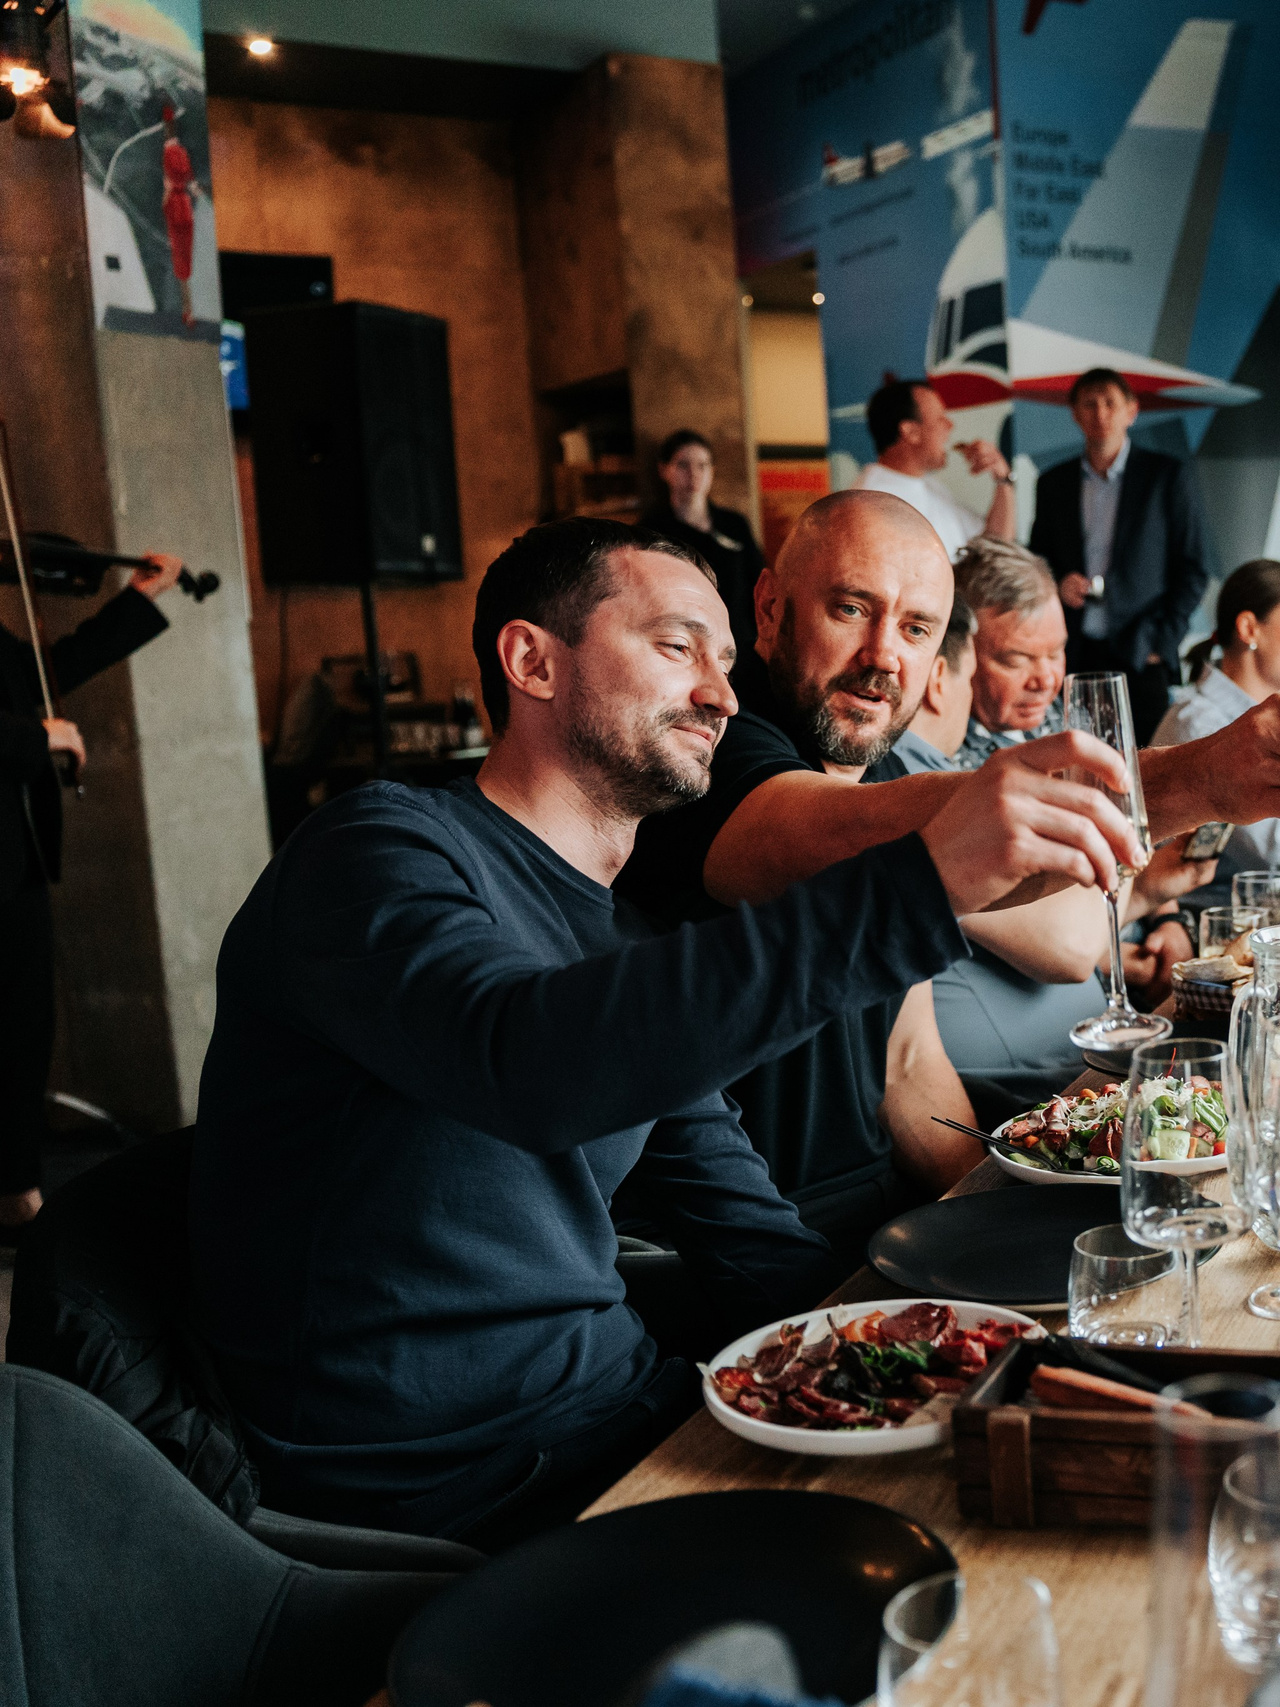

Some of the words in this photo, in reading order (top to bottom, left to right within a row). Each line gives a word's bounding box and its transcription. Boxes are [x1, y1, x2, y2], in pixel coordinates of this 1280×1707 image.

[1012, 120, 1069, 146] Europe
[1013, 151, 1065, 173] Middle
[1070, 154, 1106, 179] East
[1013, 178, 1038, 201] Far
[1045, 181, 1082, 205] East
[1015, 209, 1051, 231] USA
[1017, 235, 1062, 259] South
[1068, 240, 1133, 265] America
